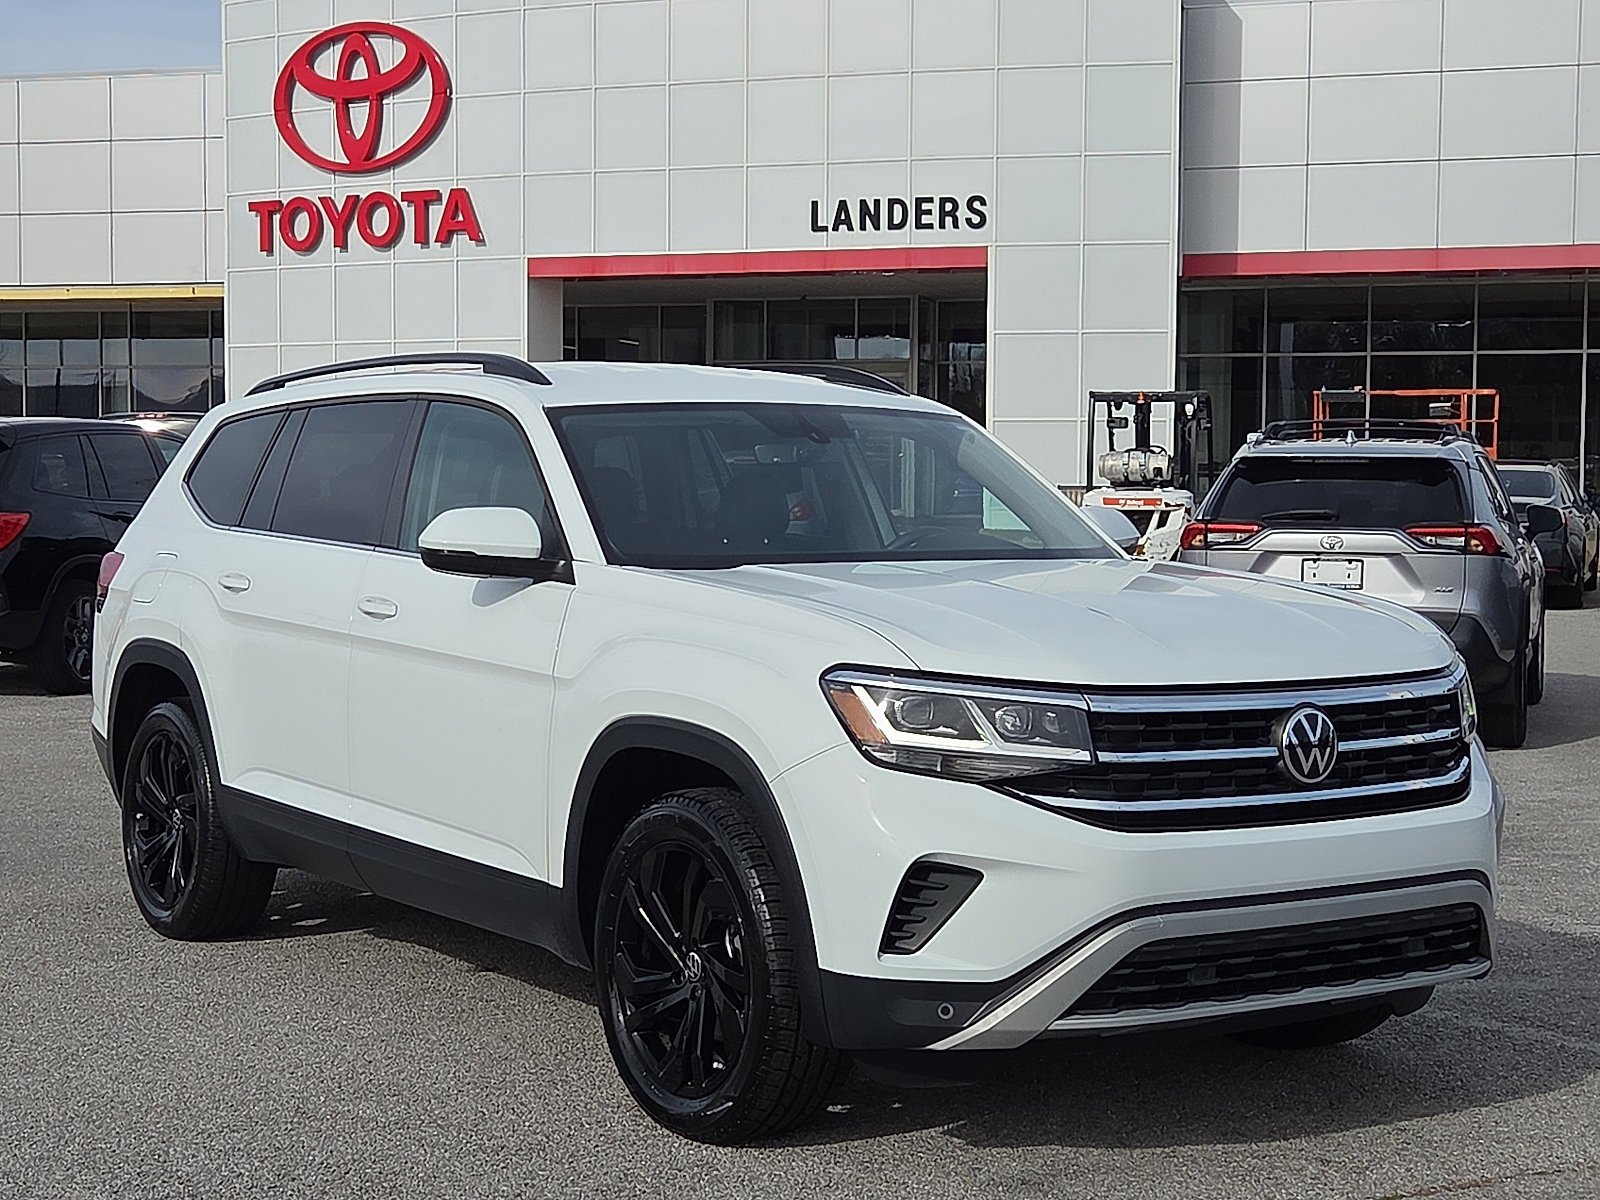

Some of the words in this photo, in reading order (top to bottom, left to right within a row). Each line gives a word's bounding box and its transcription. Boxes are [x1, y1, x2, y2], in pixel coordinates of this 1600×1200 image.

[248, 188, 486, 255] TOYOTA
[810, 195, 988, 232] LANDERS
[1283, 708, 1336, 782] VW
